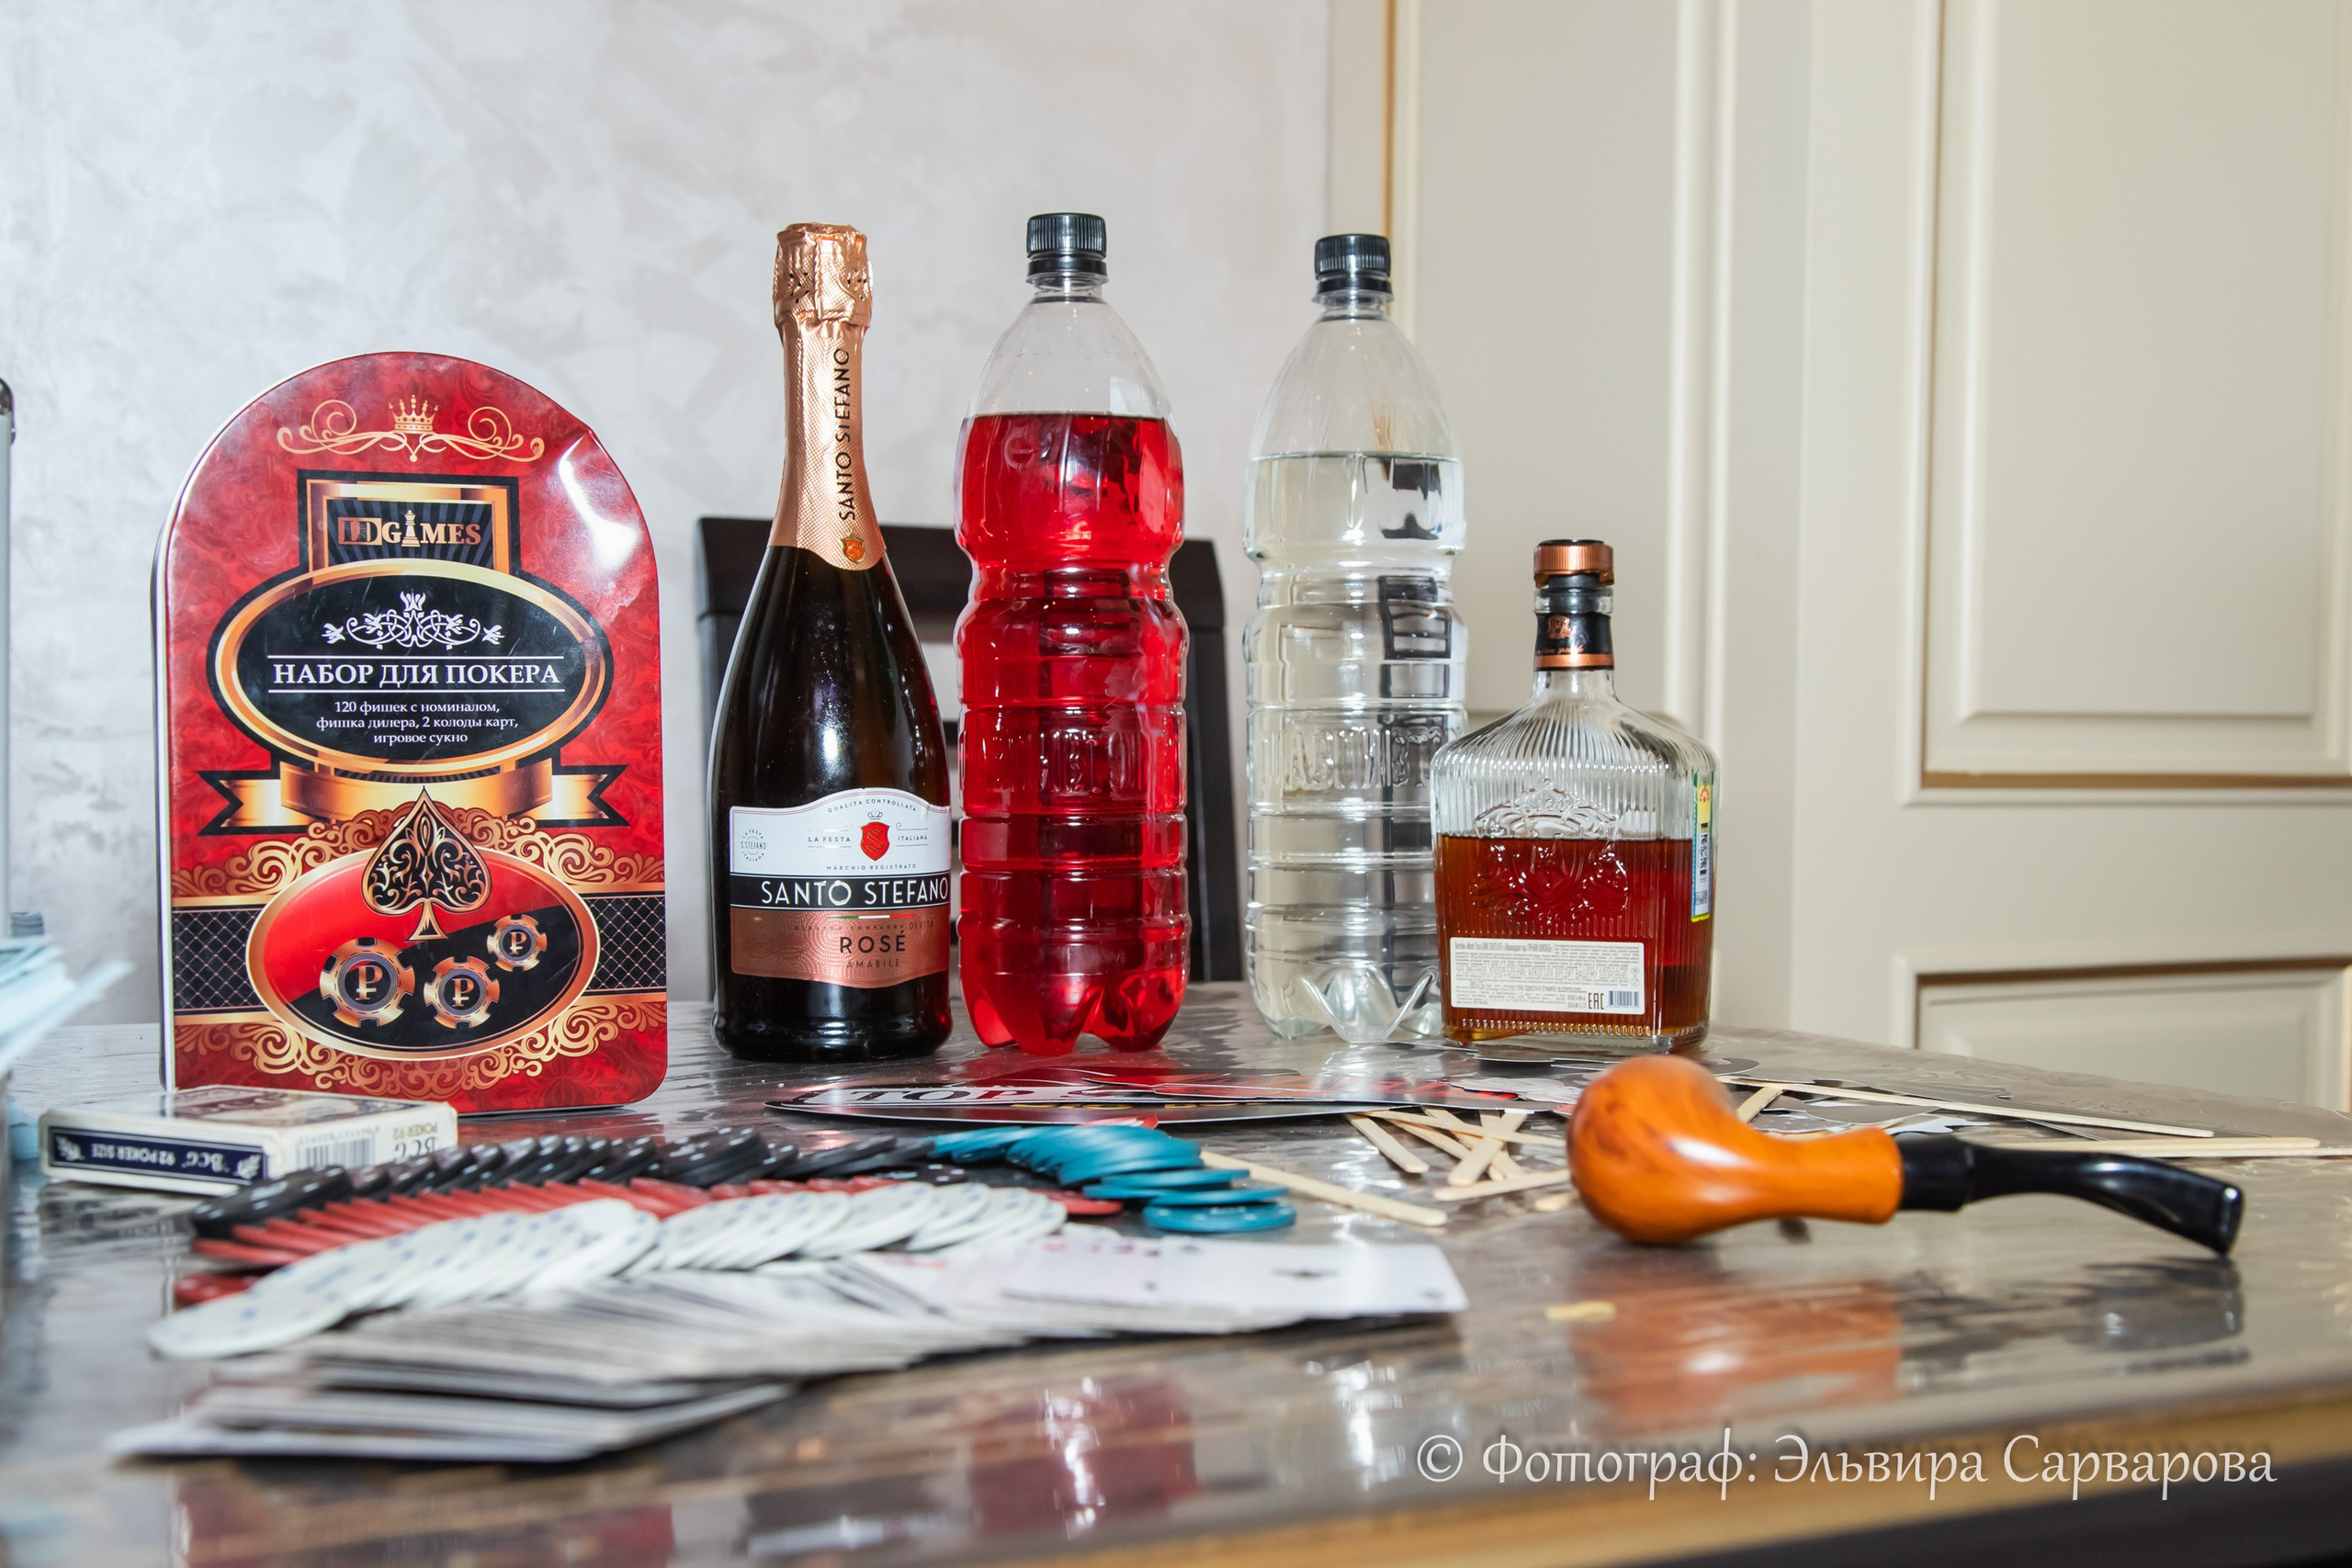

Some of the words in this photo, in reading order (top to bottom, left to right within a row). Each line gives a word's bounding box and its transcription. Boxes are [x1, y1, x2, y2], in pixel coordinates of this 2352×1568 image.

[835, 451, 856, 521] SANTO
[273, 664, 374, 683] НАБОР
[379, 664, 438, 688] ДЛЯ
[446, 664, 560, 683] ПОКЕРА
[334, 701, 356, 713] 120
[359, 701, 407, 715] фишек
[410, 704, 417, 713] с
[421, 702, 501, 714] номиналом,
[316, 716, 366, 731] фишка
[368, 717, 420, 731] дилера,
[422, 716, 431, 728] 2
[433, 717, 482, 730] колоды
[485, 716, 519, 731] карт,
[373, 733, 426, 746] игровое
[429, 733, 469, 746] сукно
[827, 800, 863, 813] QUALITA
[865, 798, 917, 812] CONTROLLATA
[761, 879, 852, 907] SANTO
[864, 876, 949, 905] STEFANO
[839, 930, 907, 954] ROSÉ
[846, 958, 901, 969] AMABILE
[851, 1089, 1035, 1101] TOP
[92, 1142, 115, 1159] SIZE
[118, 1145, 157, 1164] POKER
